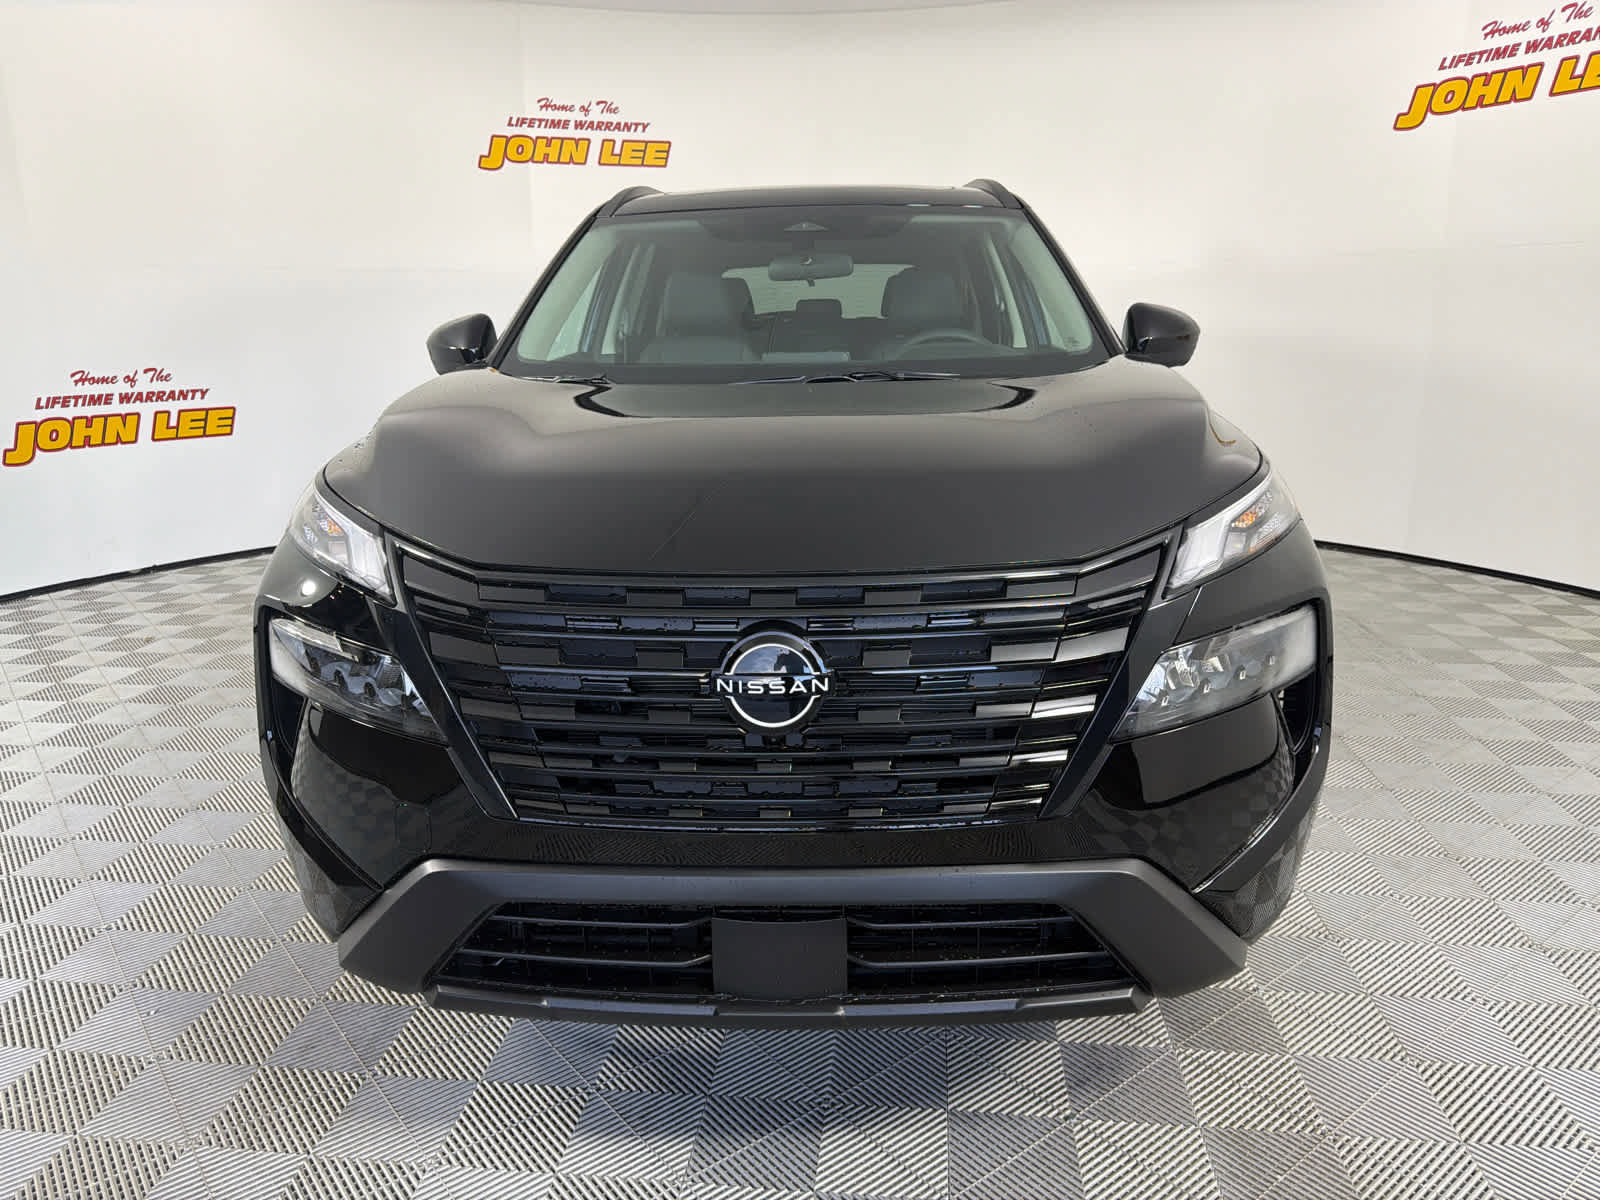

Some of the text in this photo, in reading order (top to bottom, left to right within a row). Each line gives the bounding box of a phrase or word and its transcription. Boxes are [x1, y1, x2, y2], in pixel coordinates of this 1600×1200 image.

[1481, 1, 1594, 40] Home of The
[1438, 42, 1522, 71] LIFETIME
[536, 97, 620, 116] Home of The
[1393, 62, 1545, 131] JOHN
[507, 116, 650, 133] LIFETIME WARRANTY
[478, 134, 672, 171] JOHN LEE
[70, 367, 172, 388] Home of The
[35, 388, 209, 410] LIFETIME WARRANTY
[2, 406, 236, 467] JOHN LEE
[716, 677, 829, 694] NISSAN
